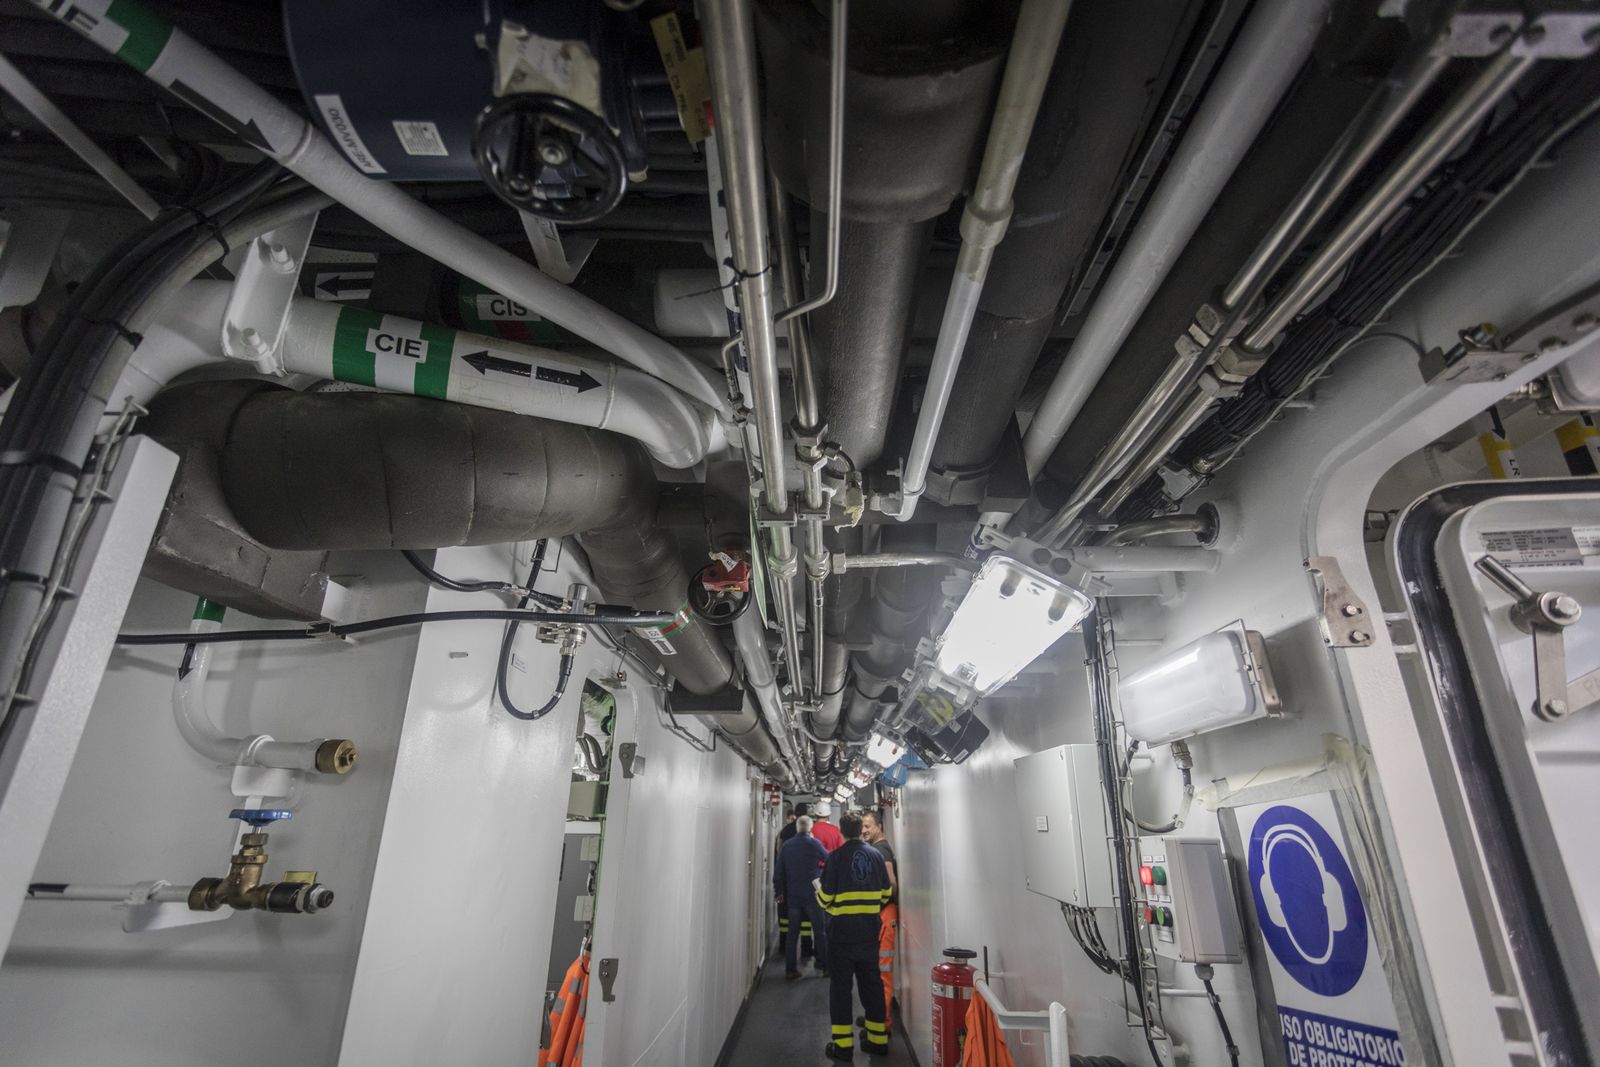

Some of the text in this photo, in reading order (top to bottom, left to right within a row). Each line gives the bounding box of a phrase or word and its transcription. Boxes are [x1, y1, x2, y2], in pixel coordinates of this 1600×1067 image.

[490, 297, 528, 316] CIS
[374, 333, 422, 359] CIE
[1288, 1041, 1307, 1067] DE
[1304, 1019, 1407, 1067] OBLIGATORIO
